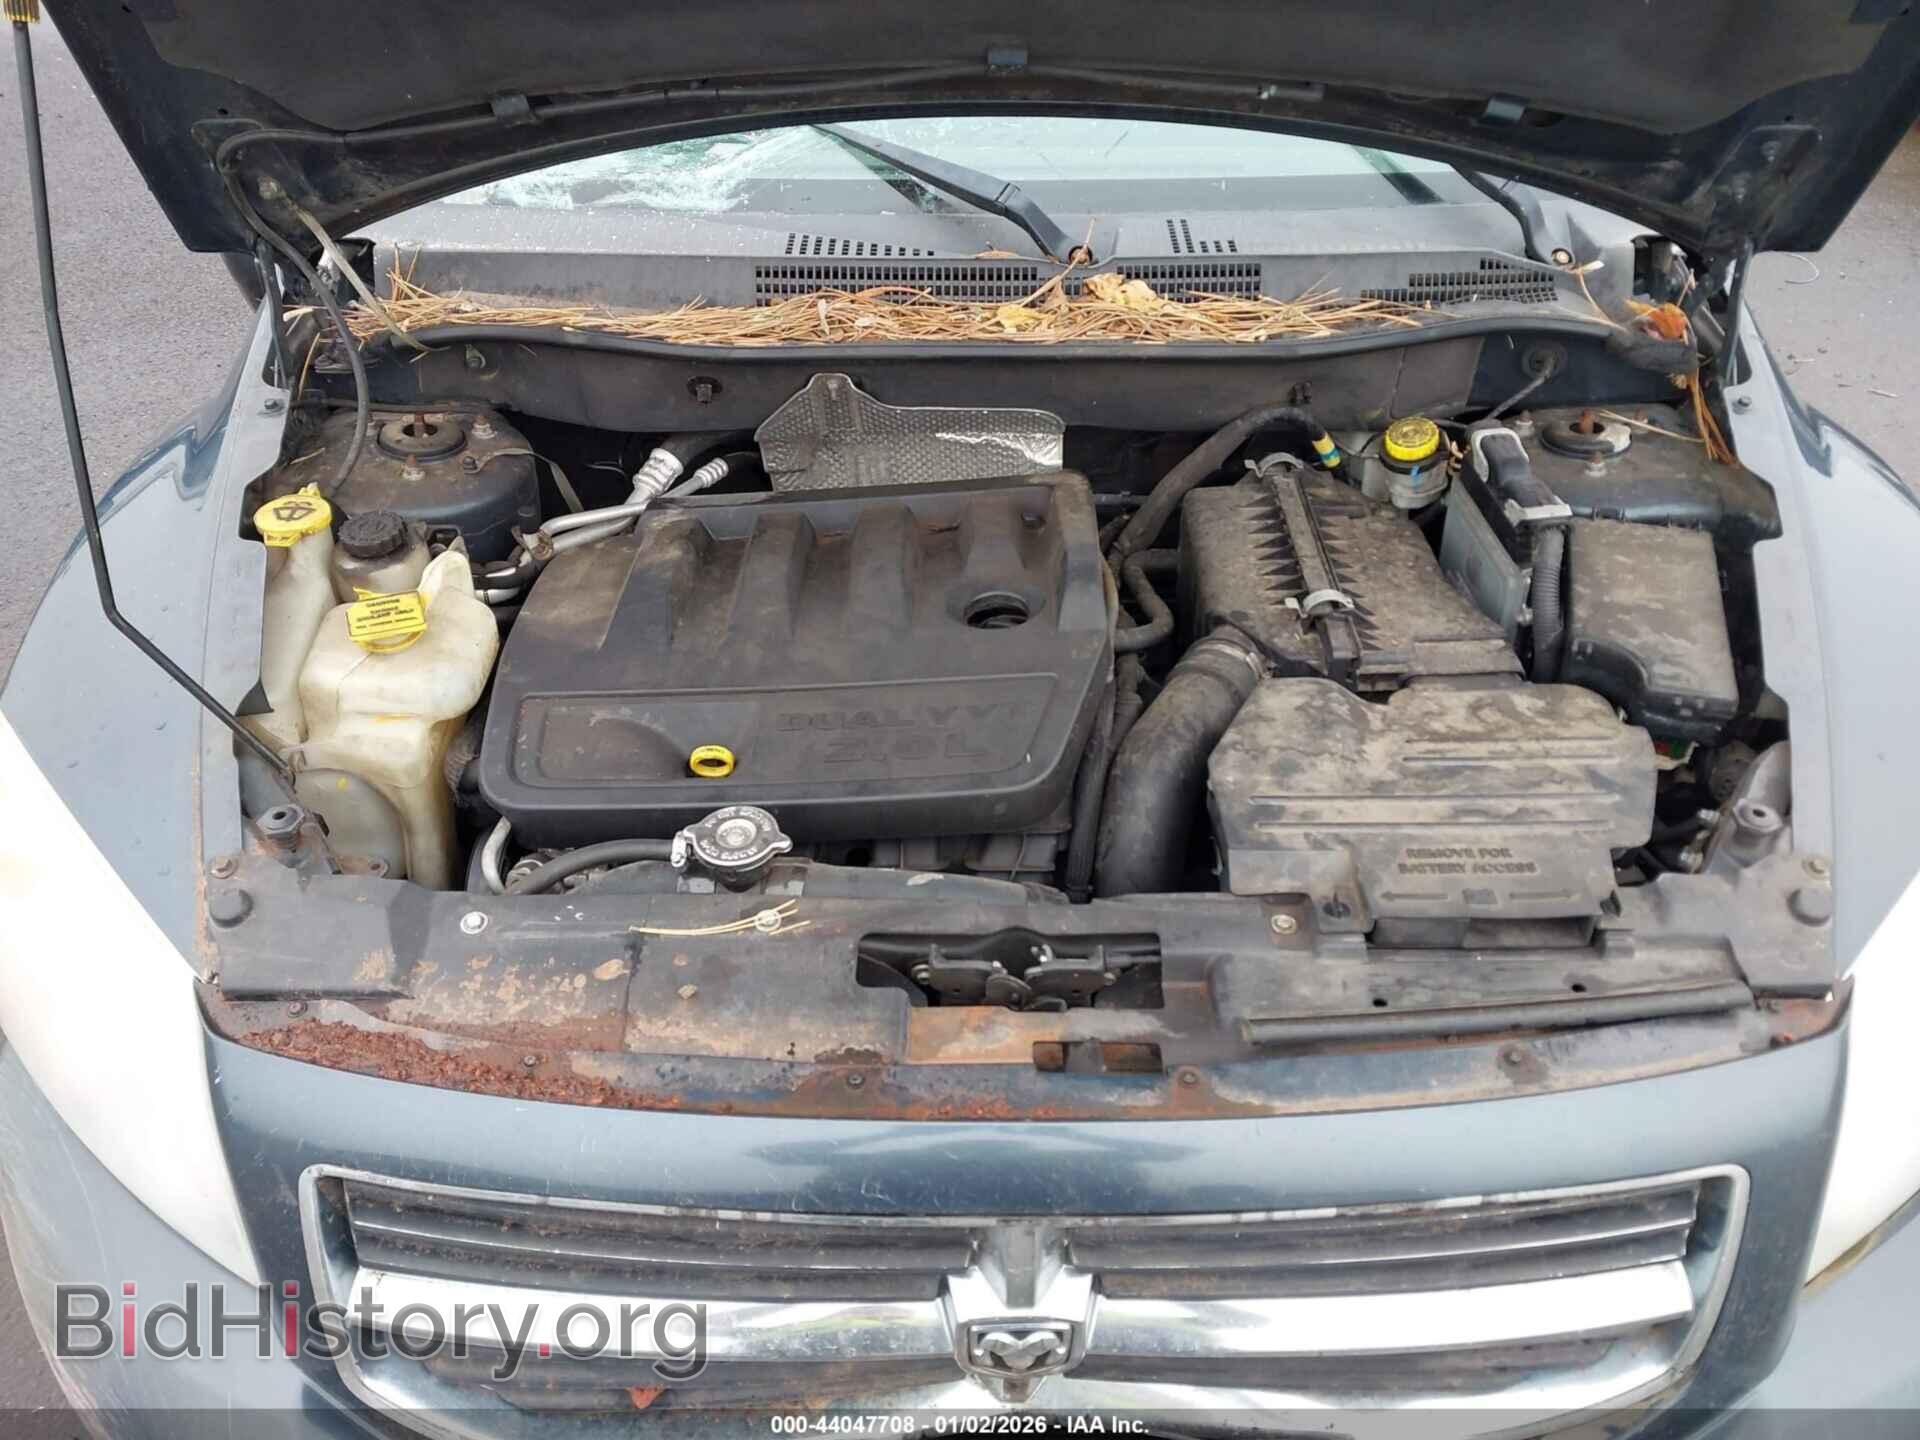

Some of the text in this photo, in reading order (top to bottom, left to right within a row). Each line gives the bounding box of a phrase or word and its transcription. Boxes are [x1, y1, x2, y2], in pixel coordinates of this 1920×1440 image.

[1405, 847, 1513, 859] REMOVE FOR
[1397, 861, 1538, 875] BATTERY ACCESS
